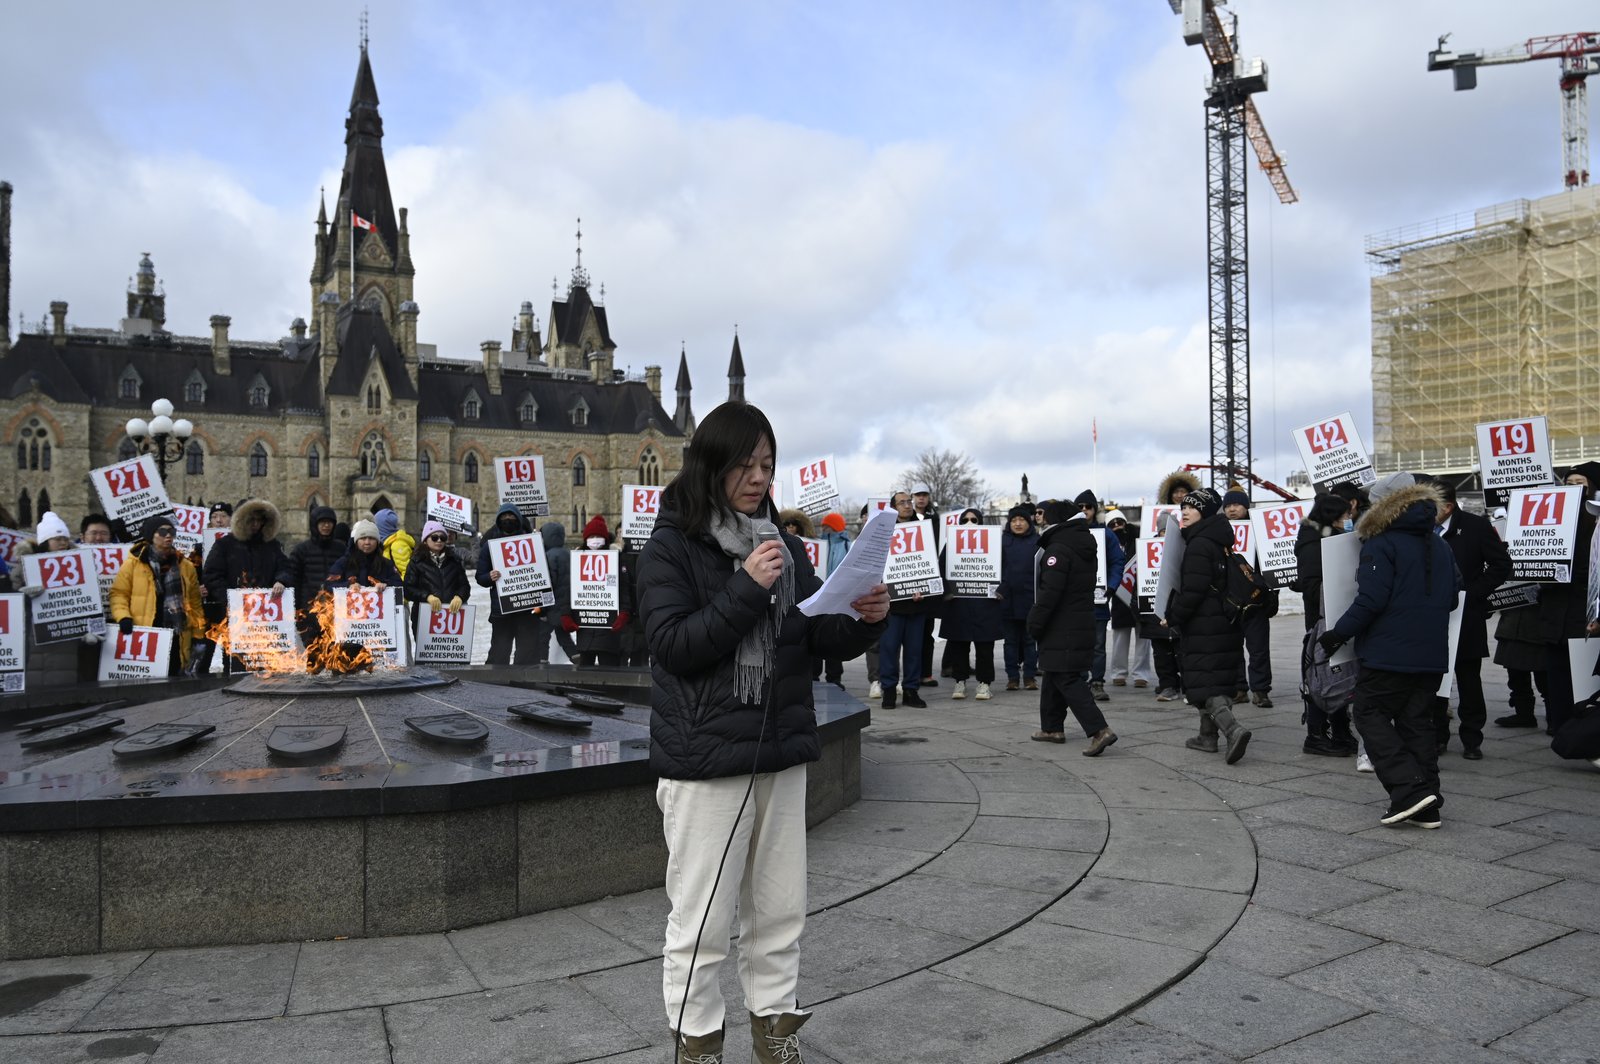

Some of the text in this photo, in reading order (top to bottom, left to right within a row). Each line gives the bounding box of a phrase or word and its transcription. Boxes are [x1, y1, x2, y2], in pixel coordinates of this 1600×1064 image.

[1313, 422, 1344, 450] 42
[1496, 424, 1528, 457] 19
[1315, 452, 1359, 470] WAITING FOR
[1319, 447, 1348, 461] MONTHS
[1313, 458, 1366, 480] IRCC RESPONSE
[1498, 457, 1532, 467] MONTHS
[509, 460, 531, 482] 19
[803, 462, 825, 484] 41
[1490, 465, 1542, 476] WAITING FOR
[111, 464, 142, 496] 27
[804, 481, 825, 491] MONTHS
[1324, 479, 1333, 488] NO
[1506, 473, 1548, 484] RESPONSE
[797, 489, 835, 506] IRCC RESPONSE
[800, 484, 832, 499] WAITING FOR
[115, 502, 146, 515] WAITING
[438, 492, 460, 510] 27
[636, 490, 660, 513] 34
[1528, 493, 1557, 526] 71
[176, 509, 201, 533] 28
[1269, 507, 1300, 539] 39
[1522, 529, 1556, 537] MONTHS
[893, 527, 917, 555] 37
[961, 530, 985, 553] 11
[1274, 541, 1297, 549] MONT
[1513, 538, 1564, 547] WAITING FOR
[505, 540, 532, 567] 30
[806, 542, 816, 565] 3
[895, 555, 922, 563] MONTHS
[1151, 542, 1162, 568] 3
[1267, 549, 1295, 558] WAITIN
[1524, 548, 1568, 556] RESPONSE
[582, 555, 606, 581] 40
[889, 563, 916, 572] WAITING
[1265, 559, 1281, 567] IRCC
[44, 556, 80, 588] 23
[509, 566, 535, 576] MONTHS
[901, 568, 935, 578] RESPONSE
[502, 580, 547, 593] IRCC RESPONSE
[504, 573, 543, 585] WAITING FOR
[48, 588, 82, 600] MONTHS
[41, 600, 75, 610] WAITING
[77, 596, 92, 605] FOR
[247, 594, 278, 621] 25
[350, 592, 380, 620] 33
[38, 604, 98, 620] IRCC RESPONSE
[47, 623, 58, 631] NO
[433, 608, 462, 634] 30
[51, 630, 61, 638] NO
[121, 631, 149, 661] 11
[118, 665, 150, 673] MONTHS
